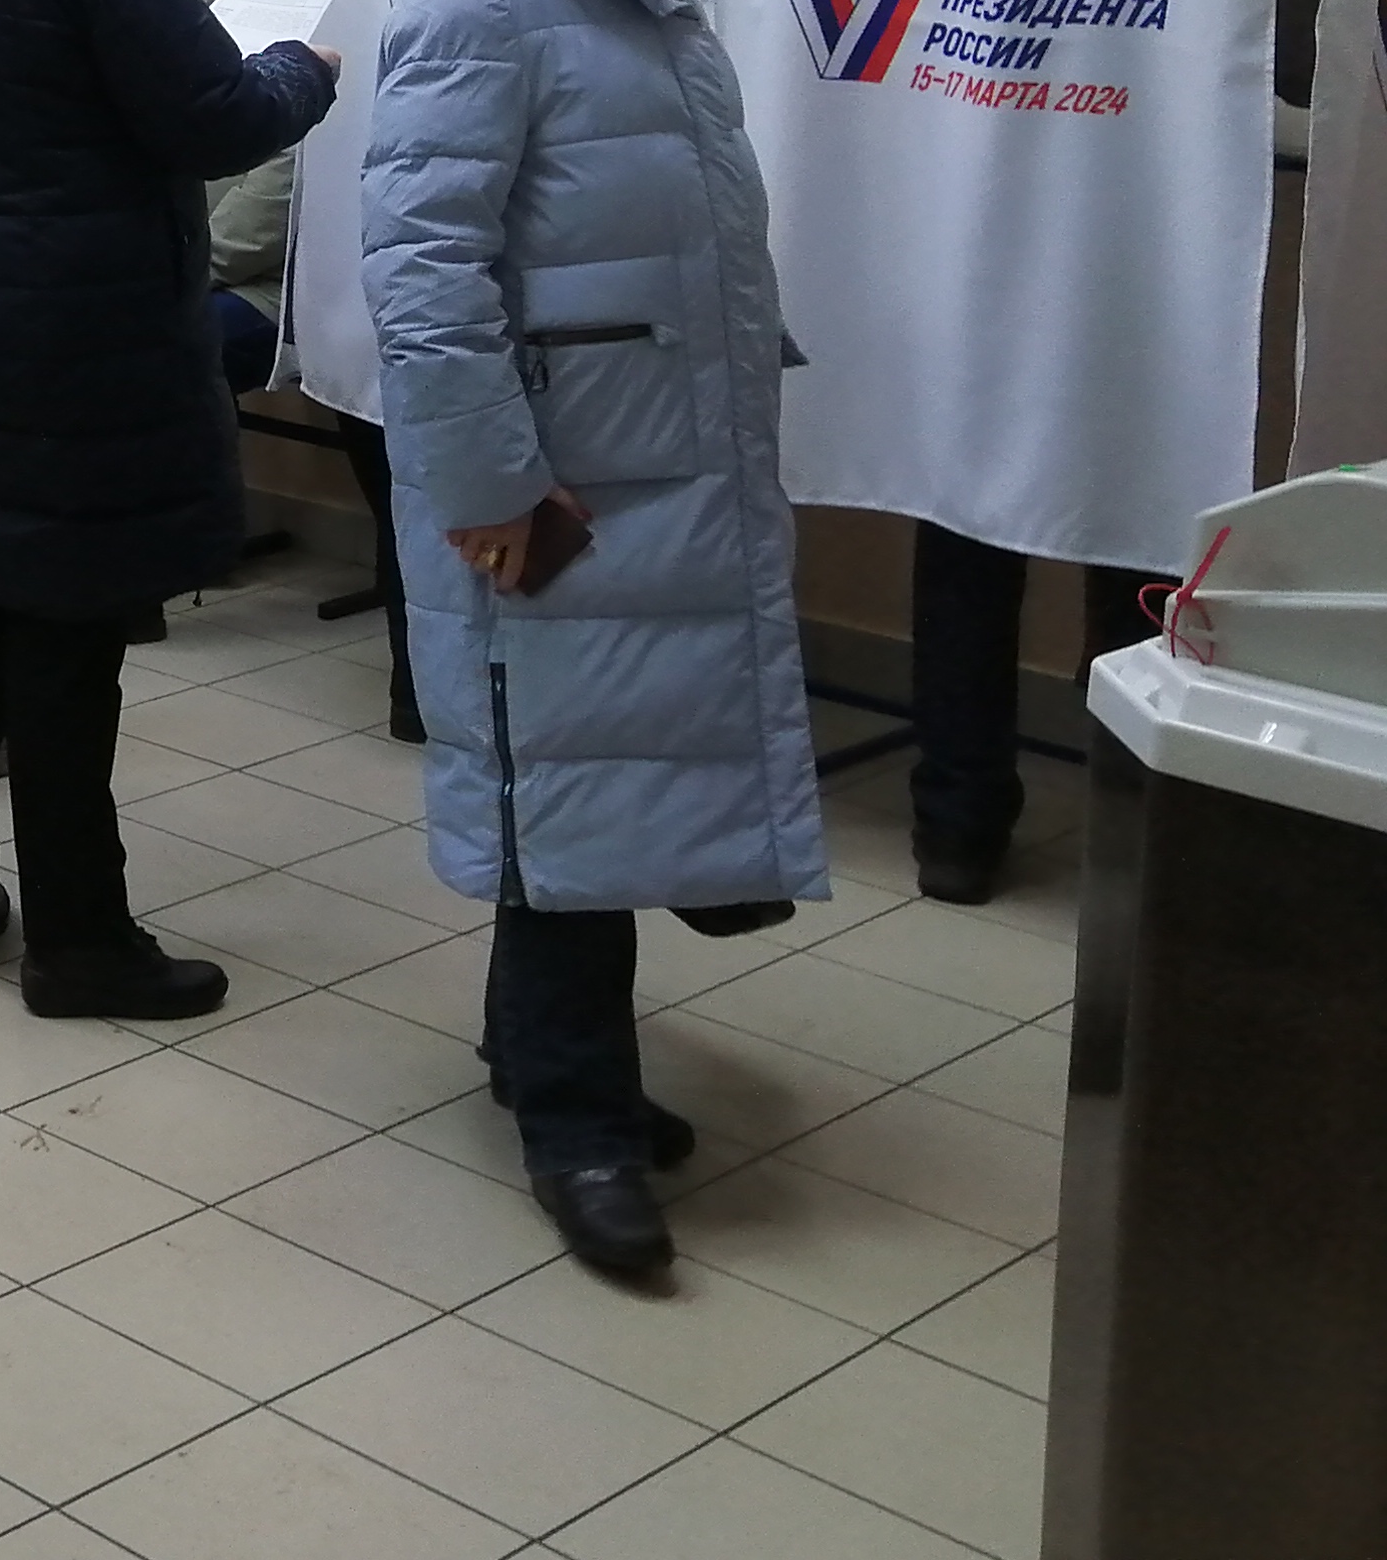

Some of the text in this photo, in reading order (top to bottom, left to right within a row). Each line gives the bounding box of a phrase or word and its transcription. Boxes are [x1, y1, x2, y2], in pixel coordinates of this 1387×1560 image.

[922, 22, 1053, 71] РОССИИ
[964, 75, 1049, 111] МАРТА
[1053, 83, 1130, 117] 2024
